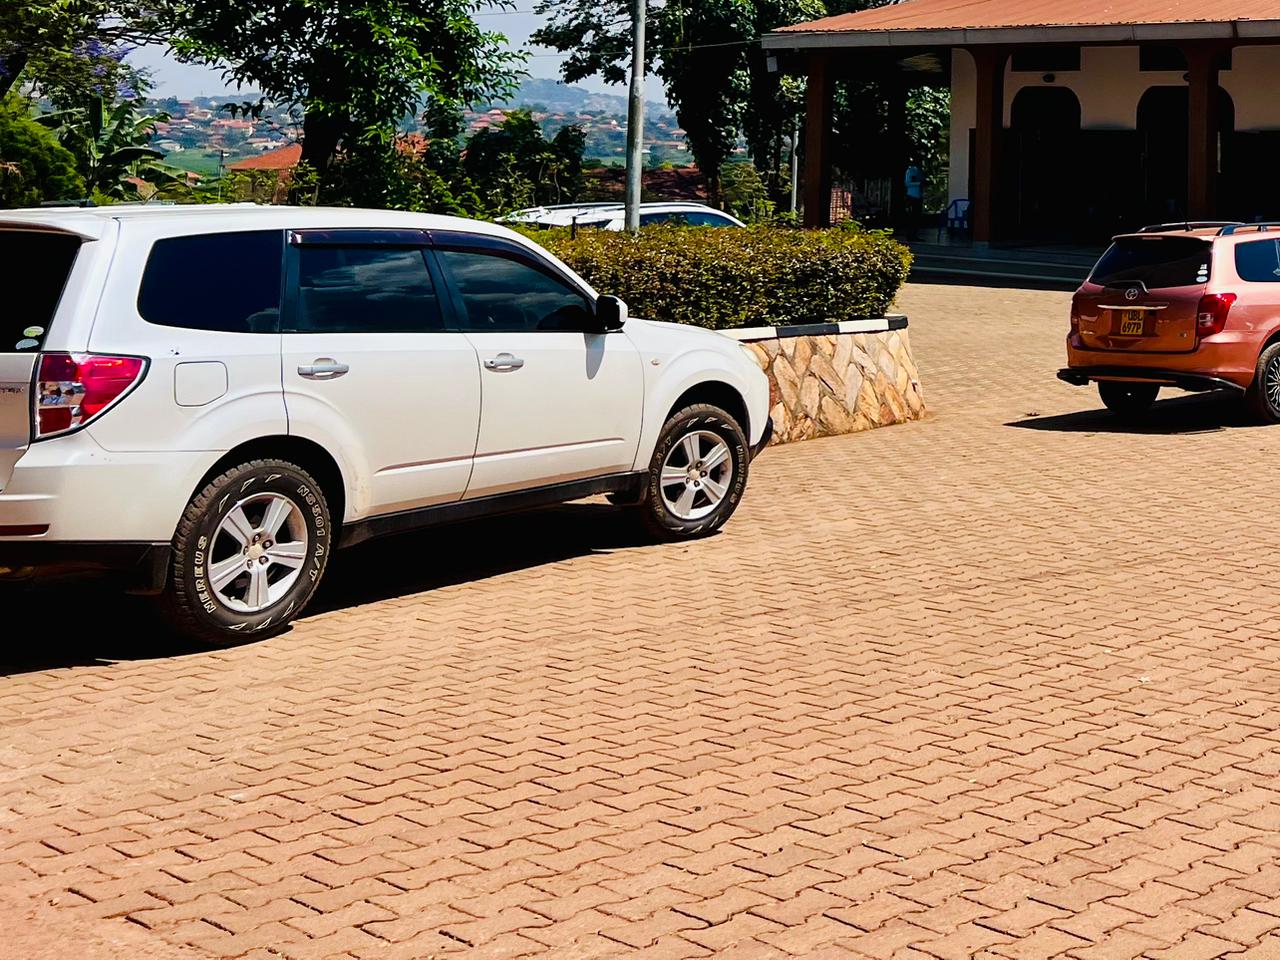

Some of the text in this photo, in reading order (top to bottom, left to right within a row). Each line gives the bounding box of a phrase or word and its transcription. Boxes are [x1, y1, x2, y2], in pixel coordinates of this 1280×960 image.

[1121, 322, 1142, 333] 697P
[297, 484, 325, 582] NS501 A/T
[194, 535, 217, 614] NEREUS
